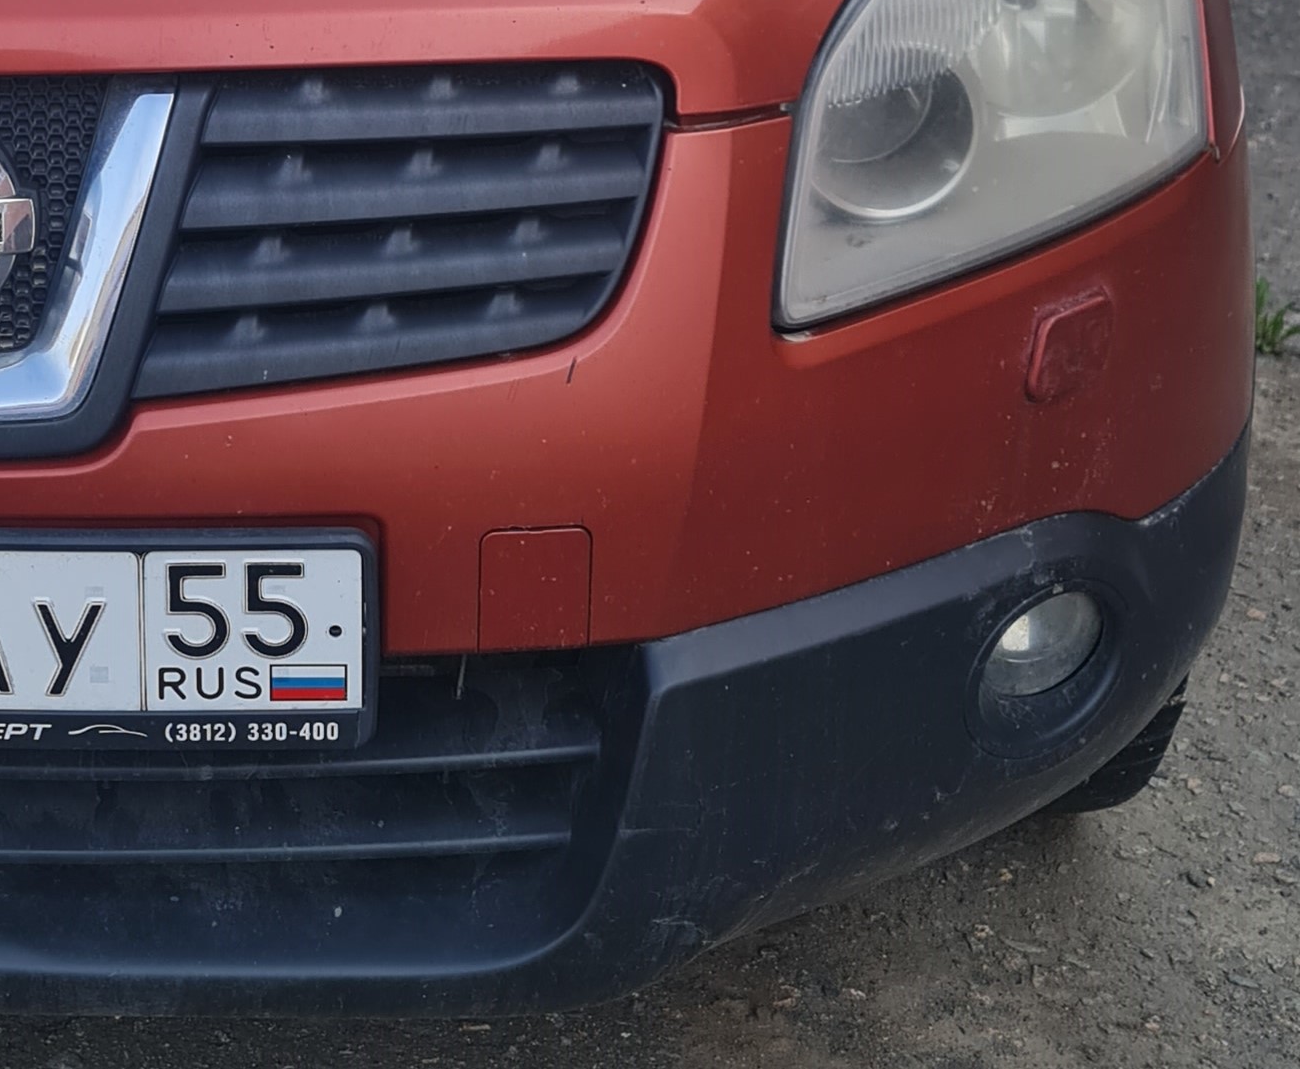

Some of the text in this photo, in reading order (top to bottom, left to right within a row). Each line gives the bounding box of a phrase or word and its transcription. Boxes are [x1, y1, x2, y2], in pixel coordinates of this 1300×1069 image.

[165, 563, 308, 658] 55
[158, 667, 262, 700] RUS
[164, 722, 339, 743] (3812) 330-400
